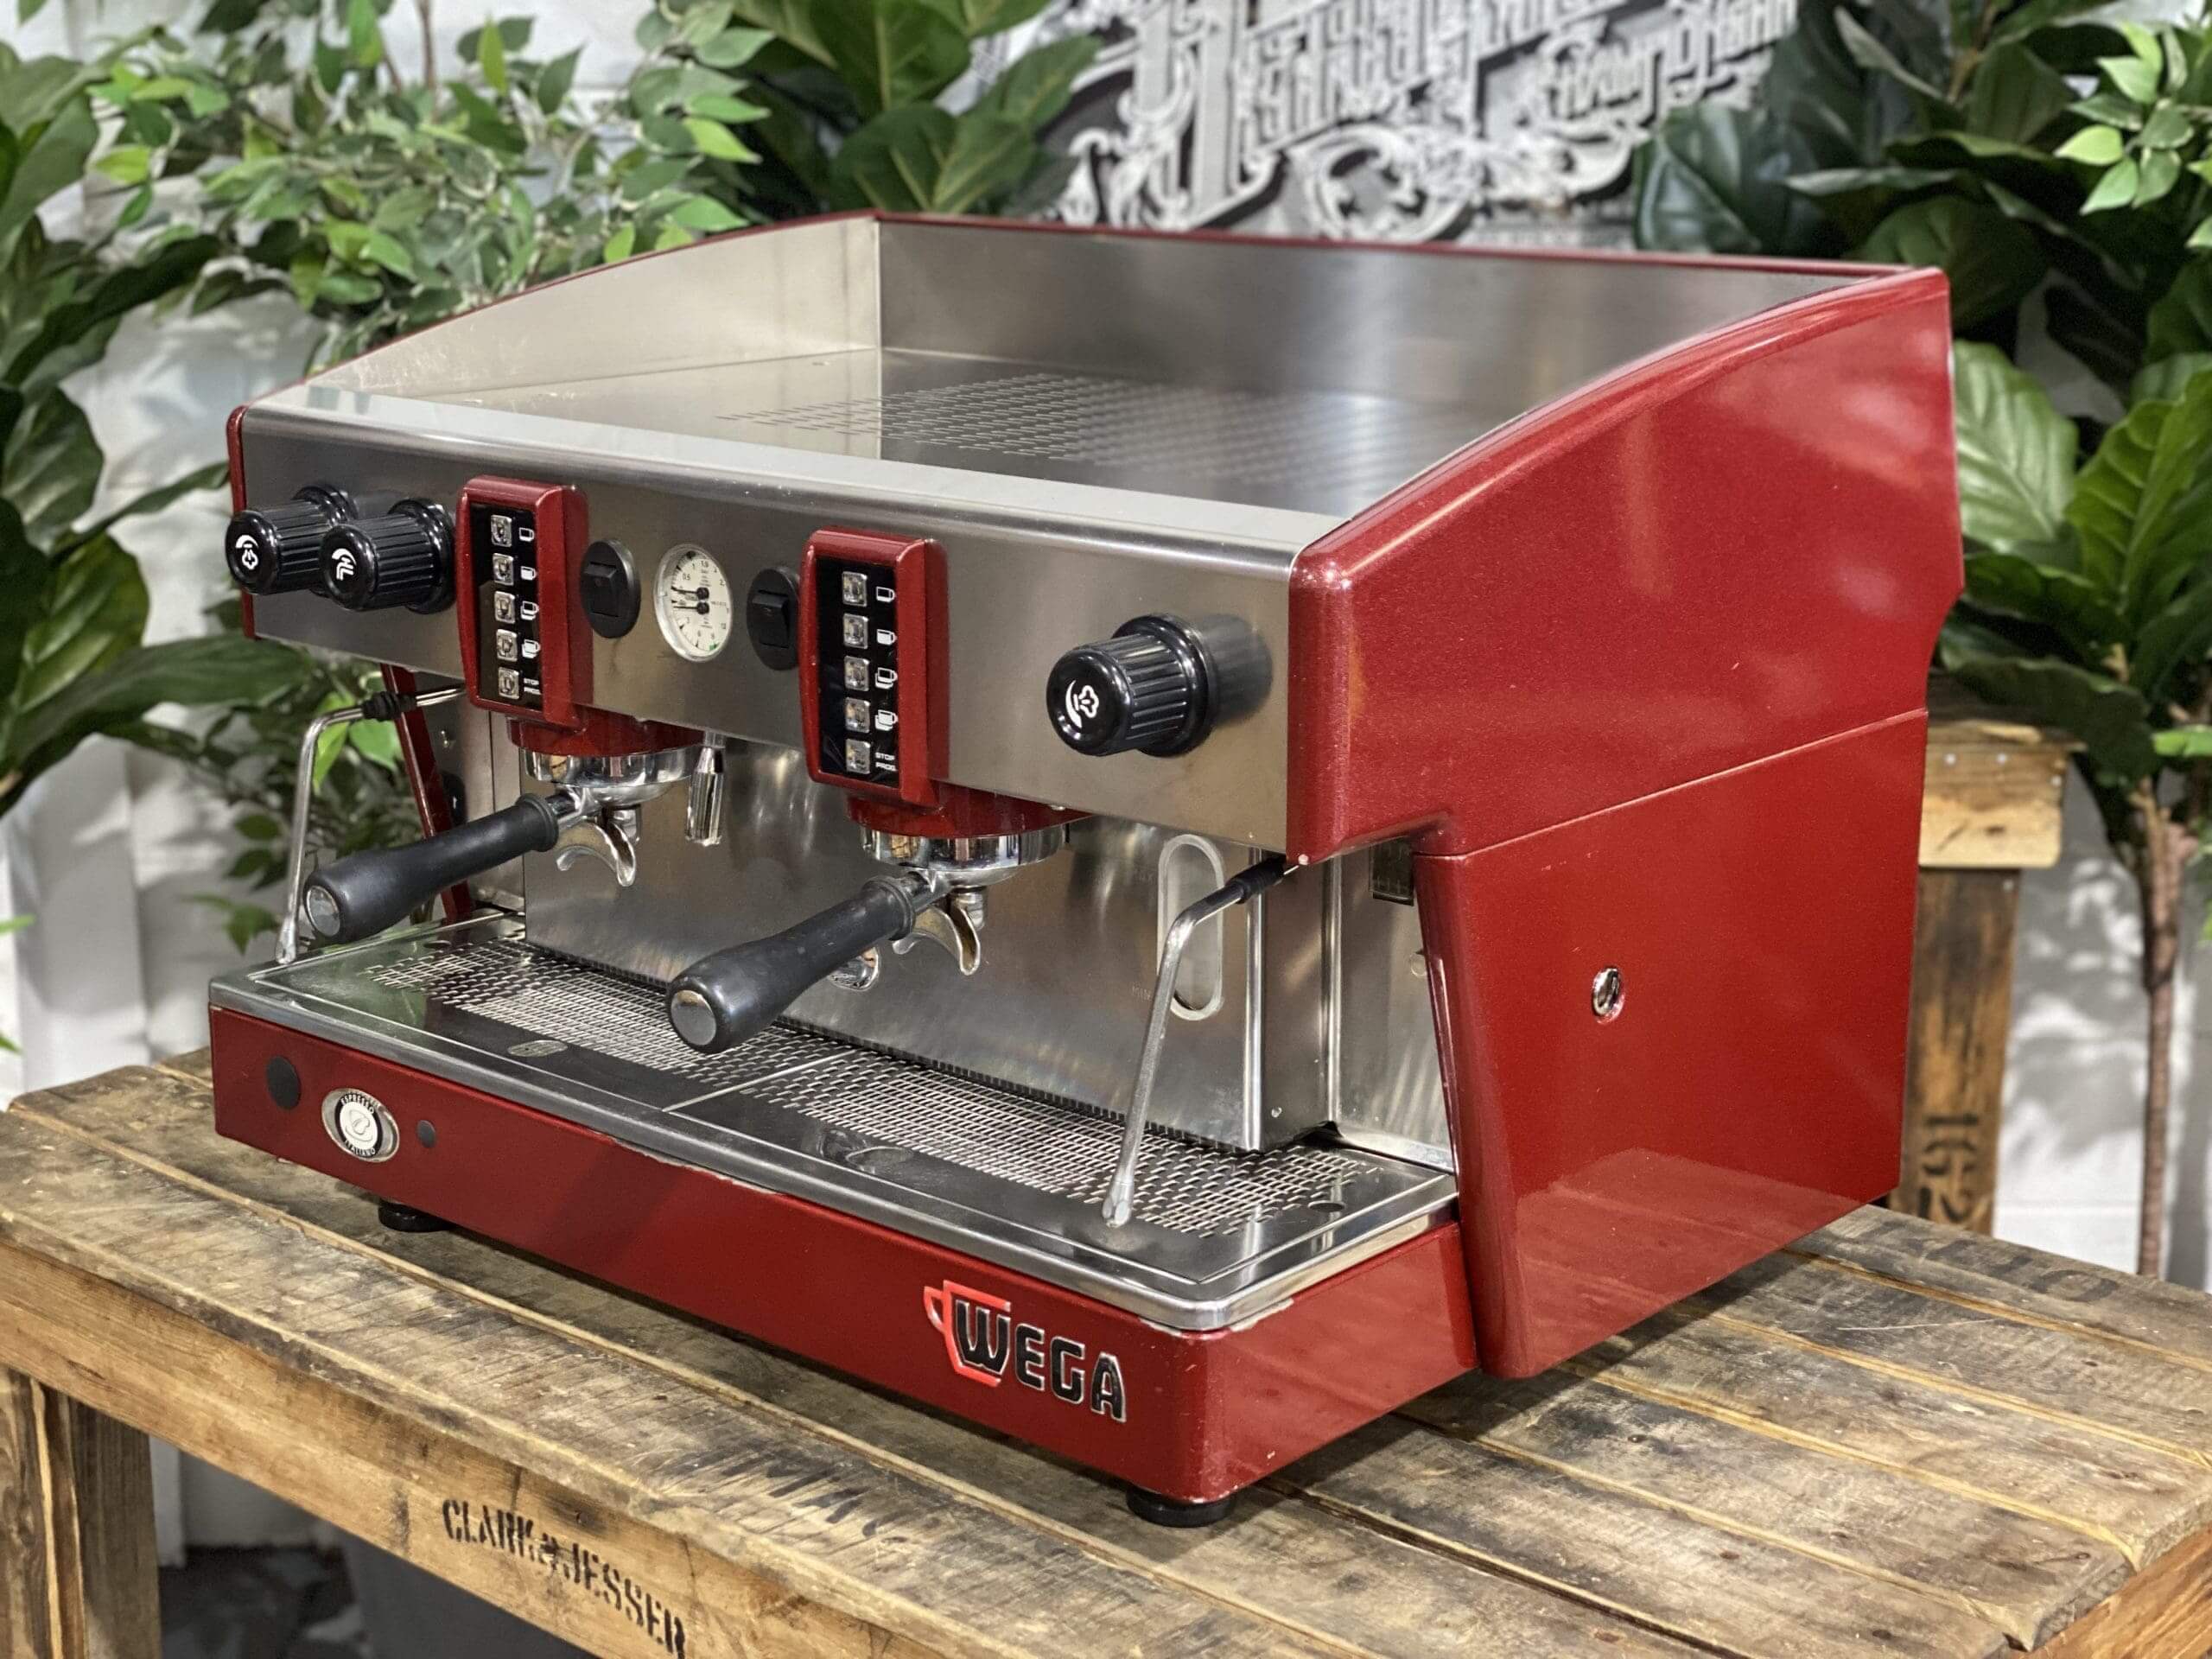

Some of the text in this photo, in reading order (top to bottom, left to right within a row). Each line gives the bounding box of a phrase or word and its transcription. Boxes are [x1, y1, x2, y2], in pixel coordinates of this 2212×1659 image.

[875, 752, 895, 760] STOP
[340, 1093, 375, 1114] ESPRESSO
[345, 1140, 376, 1156] ITALIANO
[955, 1299, 1127, 1423] WEGA
[442, 1498, 535, 1562] CLARK
